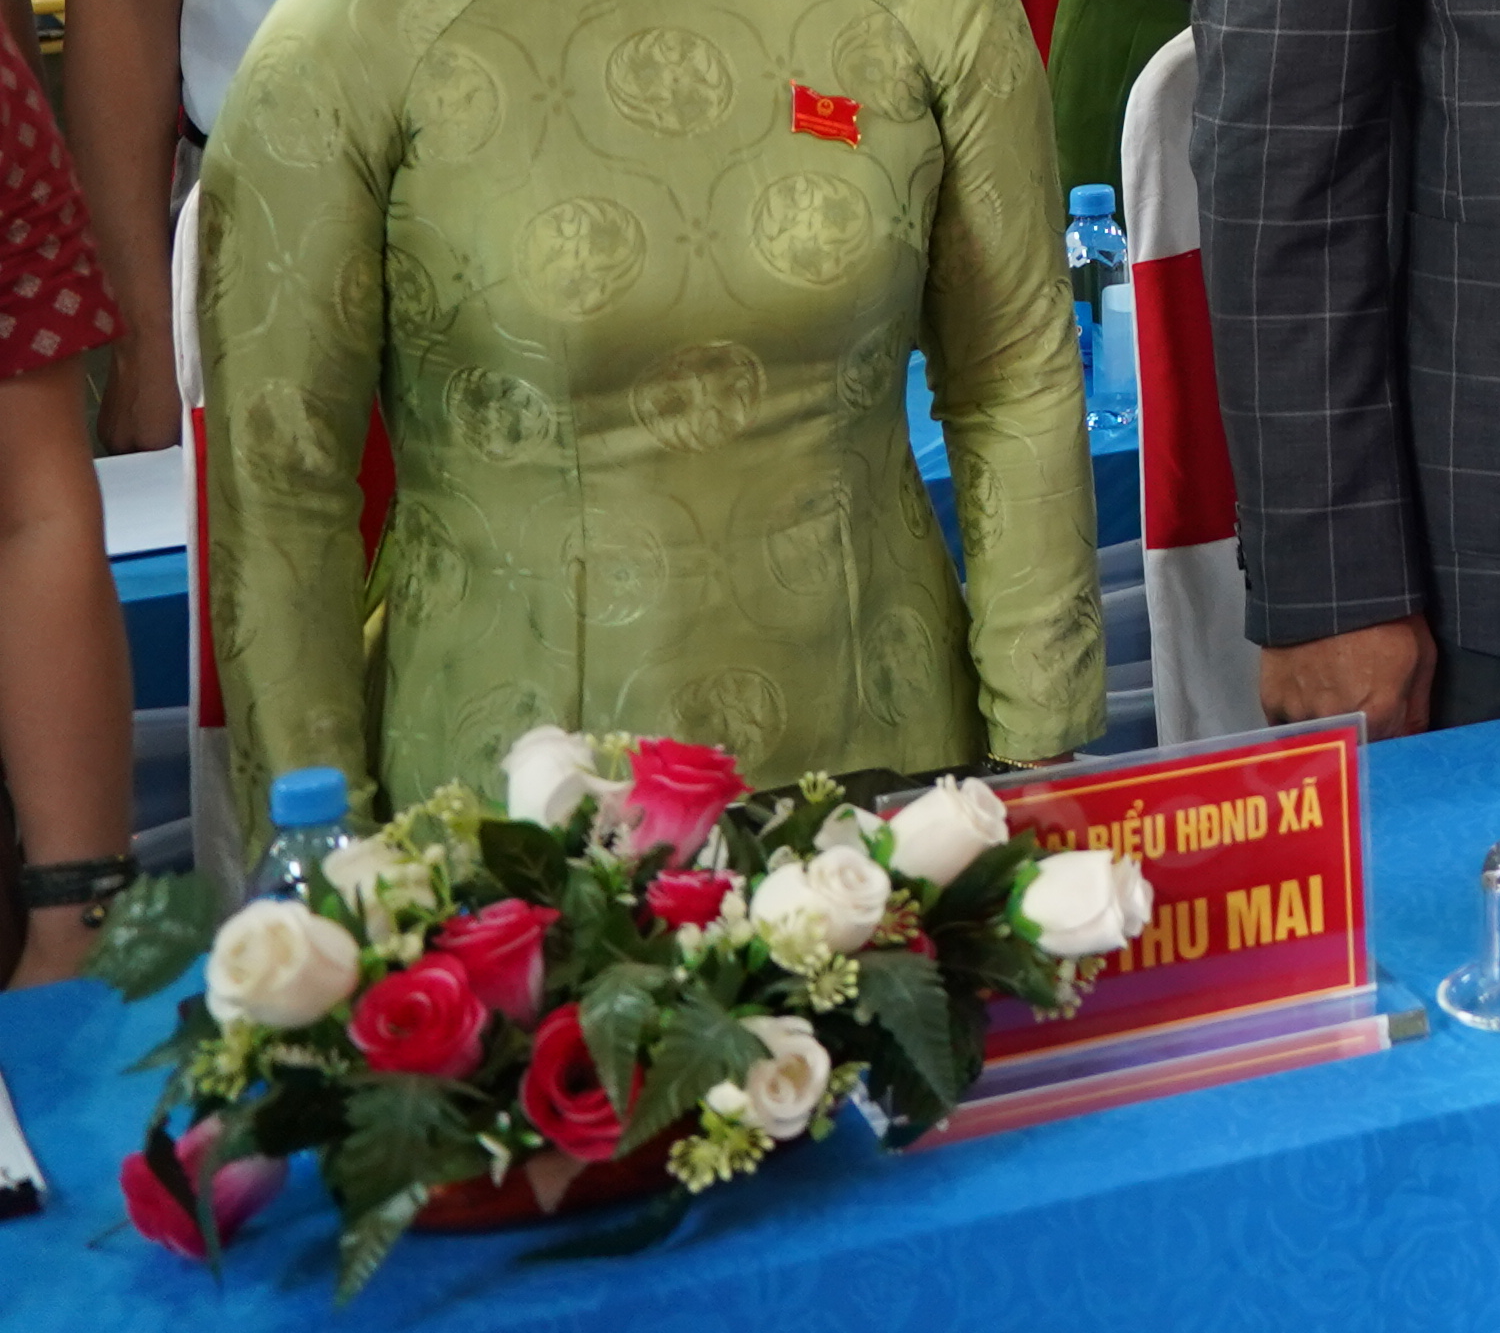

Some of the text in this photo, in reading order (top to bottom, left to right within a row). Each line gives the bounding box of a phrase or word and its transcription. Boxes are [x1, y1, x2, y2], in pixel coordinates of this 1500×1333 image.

[1088, 776, 1324, 865] BIỂU HĐND XÃ
[1226, 874, 1325, 950] MAI
